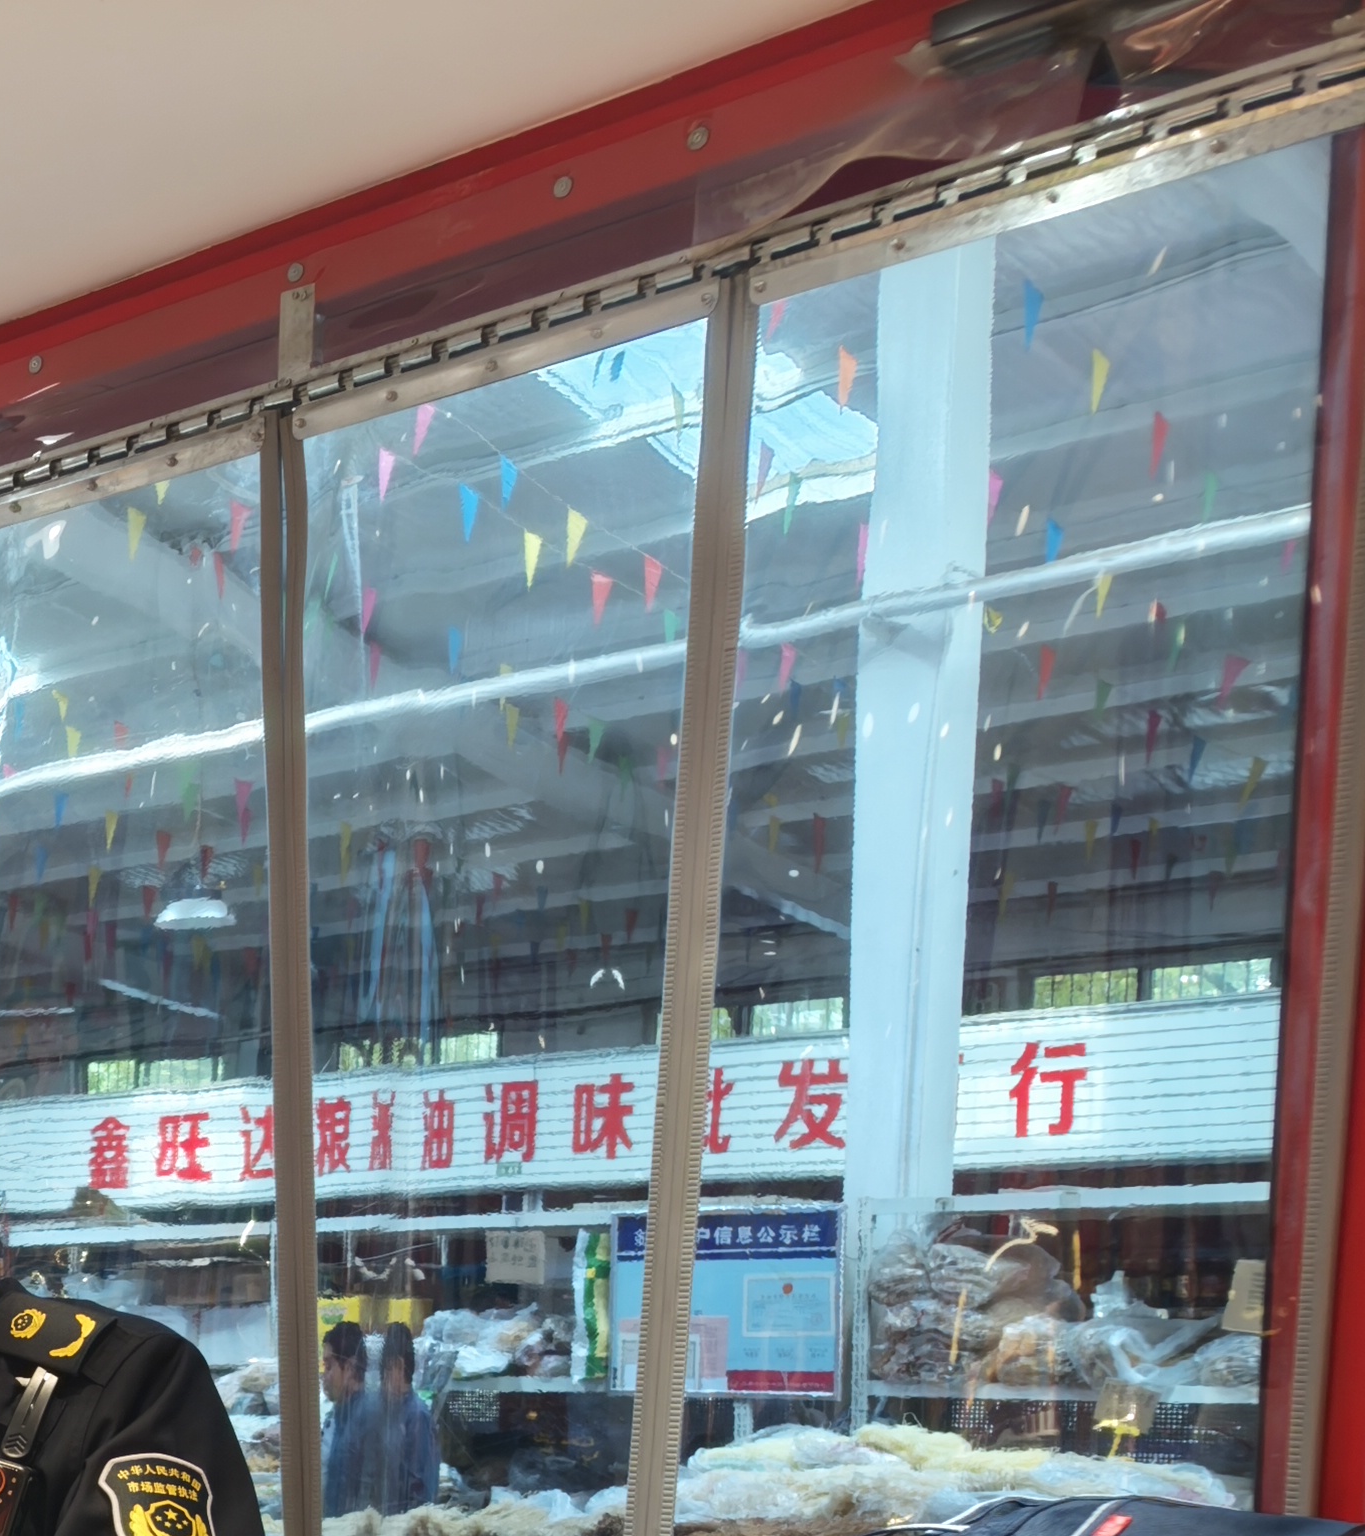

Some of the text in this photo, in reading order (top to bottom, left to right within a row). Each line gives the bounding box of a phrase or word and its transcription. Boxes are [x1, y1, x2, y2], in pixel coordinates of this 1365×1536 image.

[117, 1462, 202, 1491] 中华人民共和国
[127, 1480, 199, 1503] 市场监管执法
